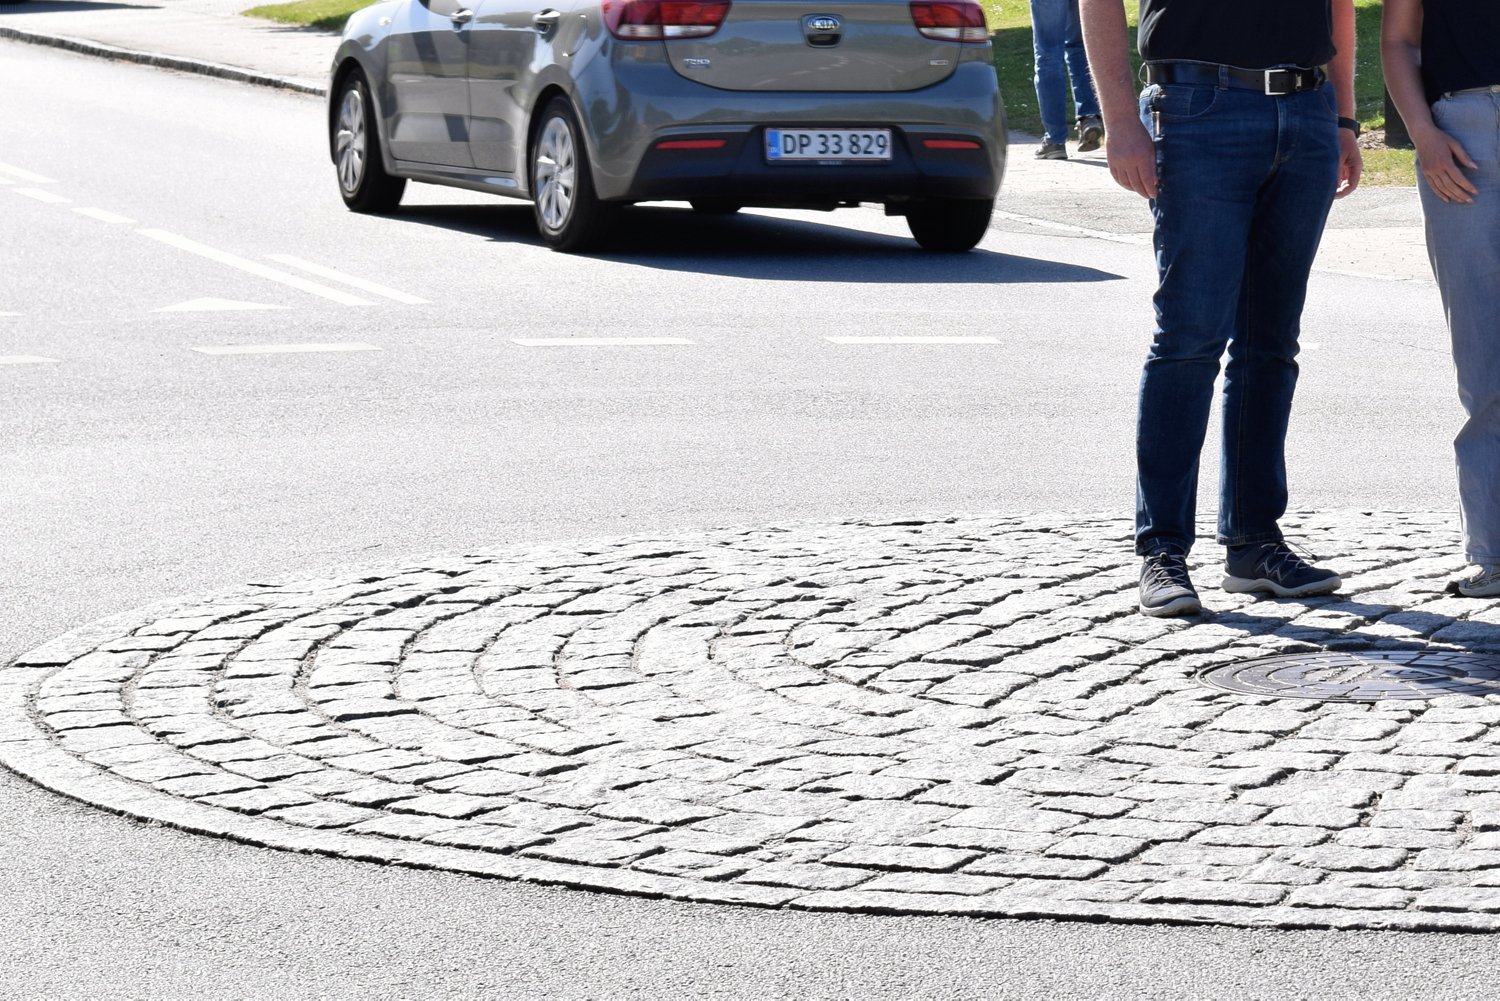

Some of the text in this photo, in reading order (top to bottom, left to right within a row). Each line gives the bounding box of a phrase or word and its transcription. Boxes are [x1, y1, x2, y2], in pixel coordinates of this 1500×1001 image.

[782, 133, 888, 155] DP 33 829
